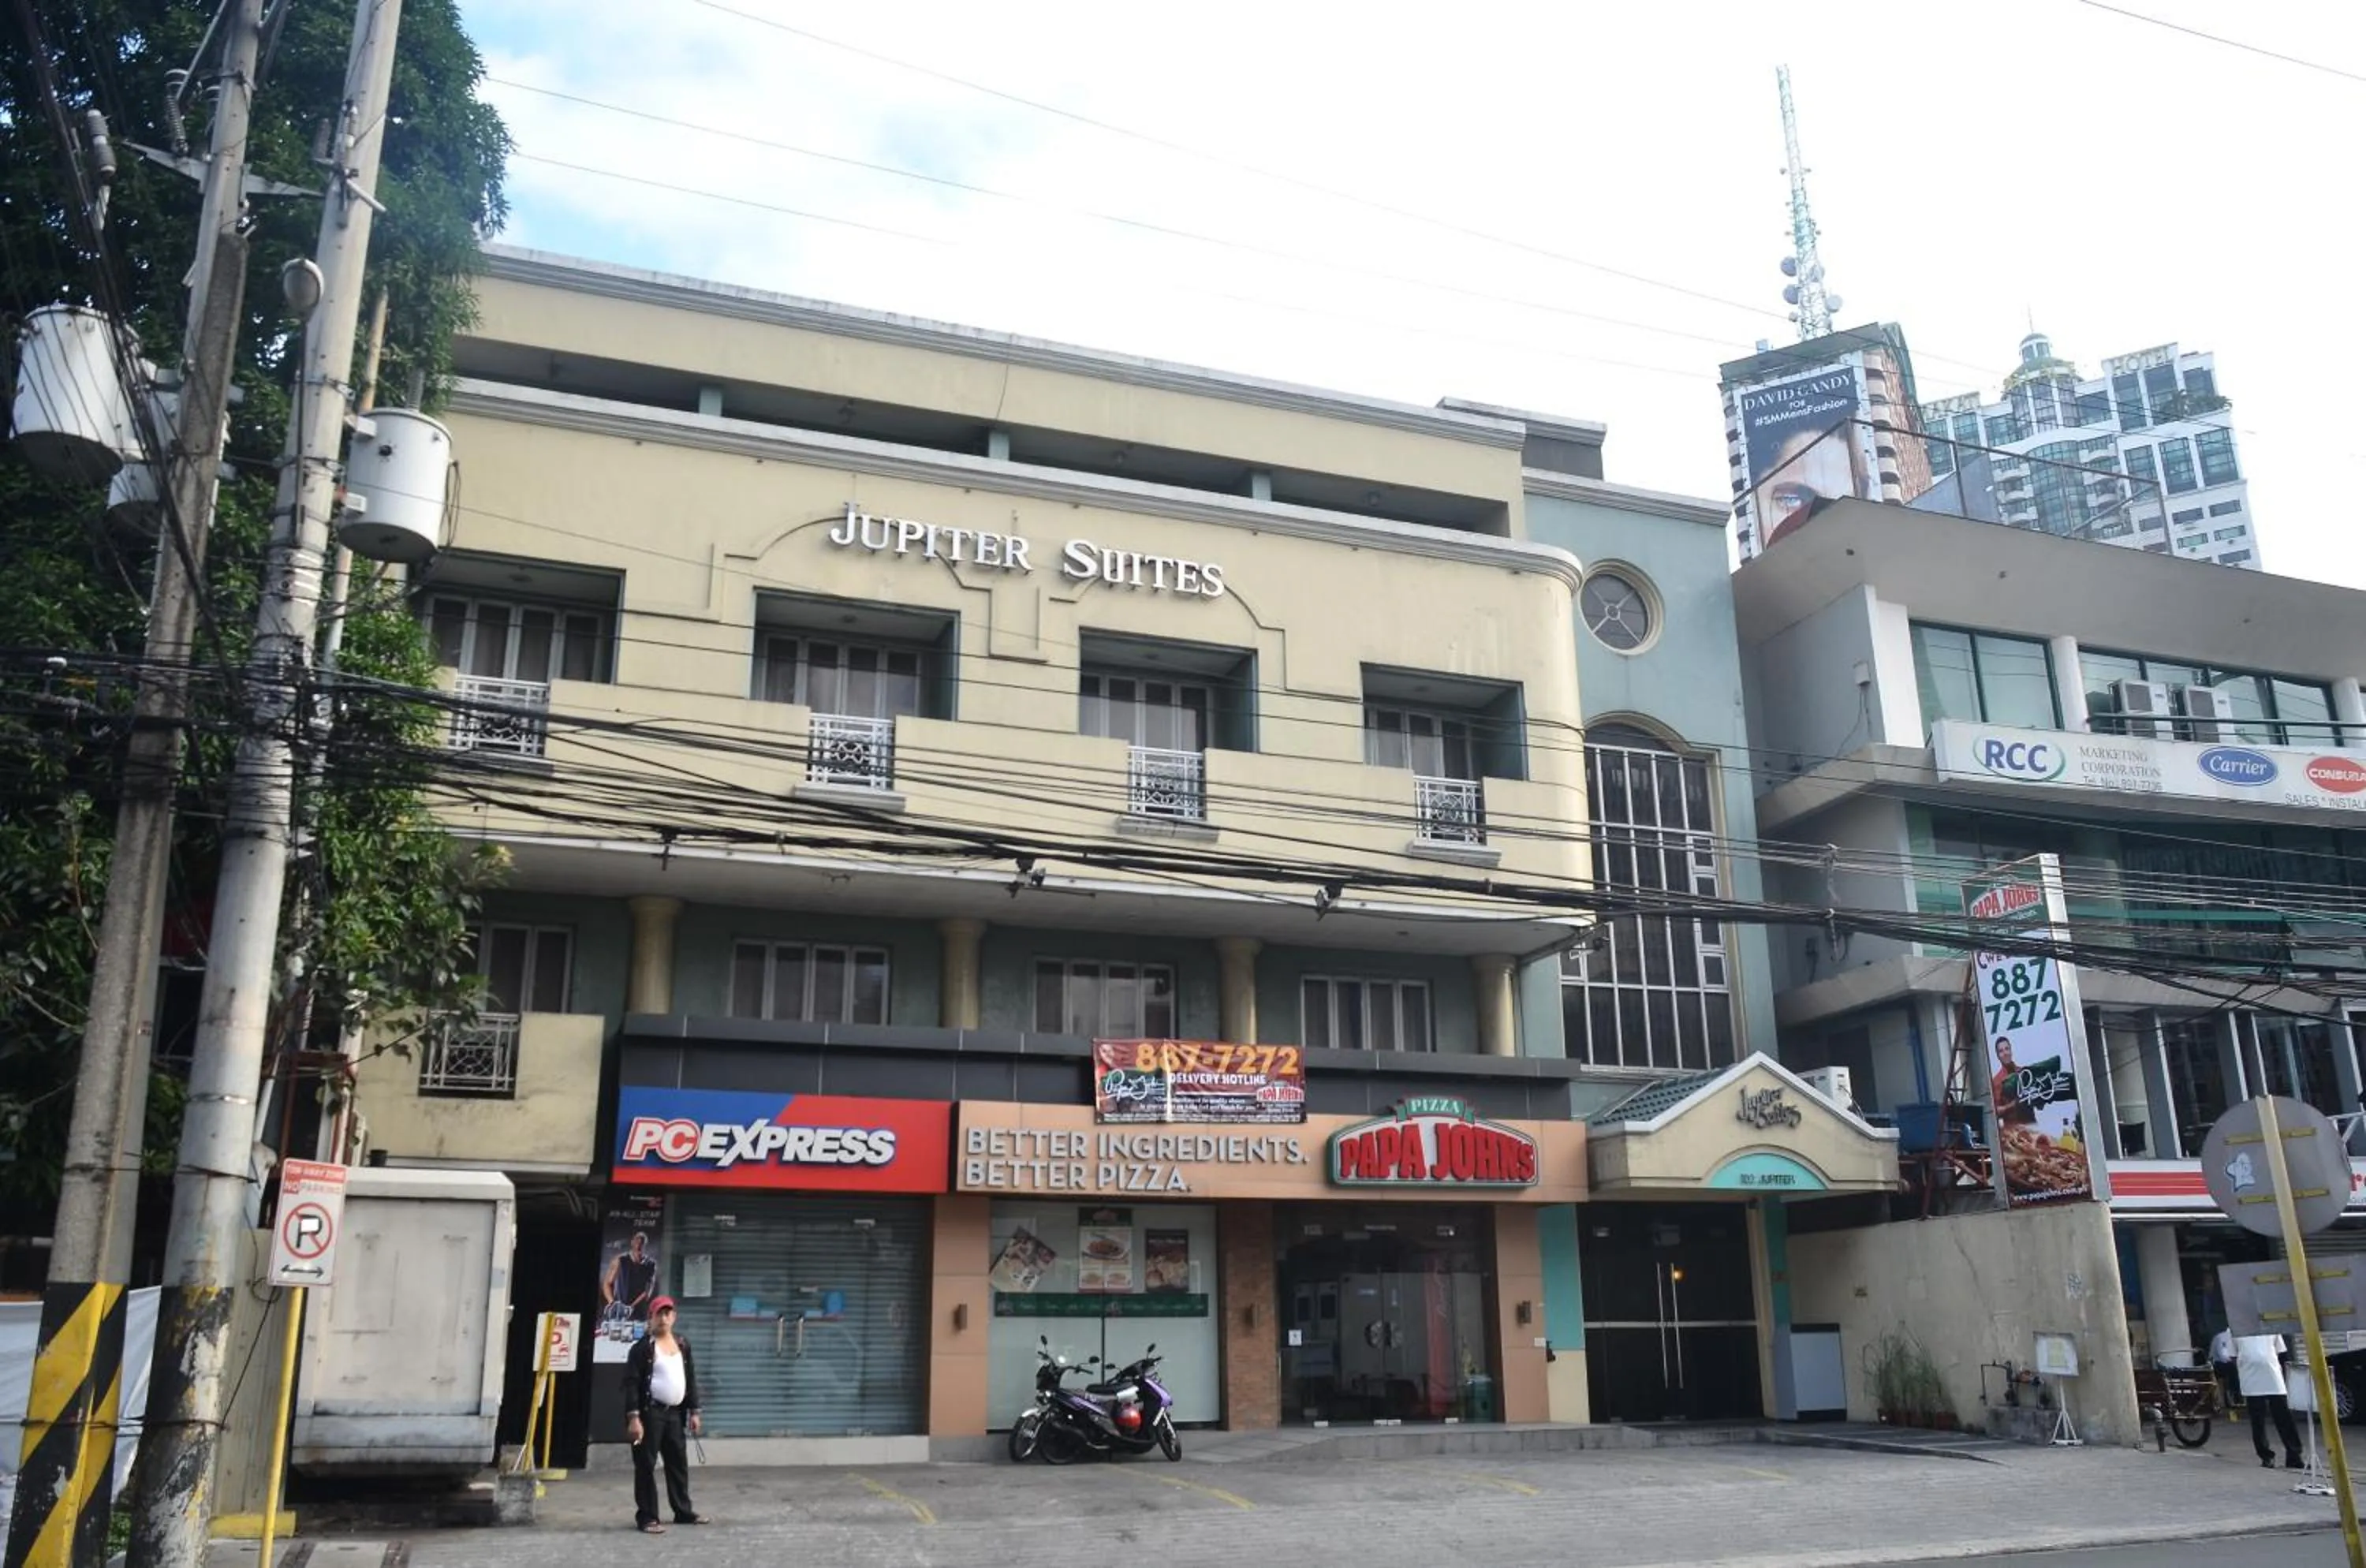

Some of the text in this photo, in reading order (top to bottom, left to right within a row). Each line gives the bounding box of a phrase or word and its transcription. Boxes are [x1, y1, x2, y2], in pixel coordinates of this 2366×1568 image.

[1744, 373, 1852, 411] DAVID GANDY
[829, 502, 1226, 599] JUPITER SUITES
[1984, 738, 2048, 773] RCC
[2080, 746, 2148, 763] MARKETING
[2081, 760, 2162, 778] CORPORATION
[2209, 754, 2268, 777] Carrier
[2285, 793, 2319, 808] SALES
[1972, 891, 2002, 921] PAPA
[1991, 957, 2047, 999] 887
[1984, 991, 2061, 1035] 7272
[1168, 1072, 1267, 1086] DELIVERY HOTLINE
[1410, 1097, 1460, 1113] PIZZA
[966, 1126, 1310, 1164] BETTER INGREDIENTS.
[1340, 1123, 1427, 1180] PAPA
[965, 1159, 1192, 1193] BETTER PIZZA.
